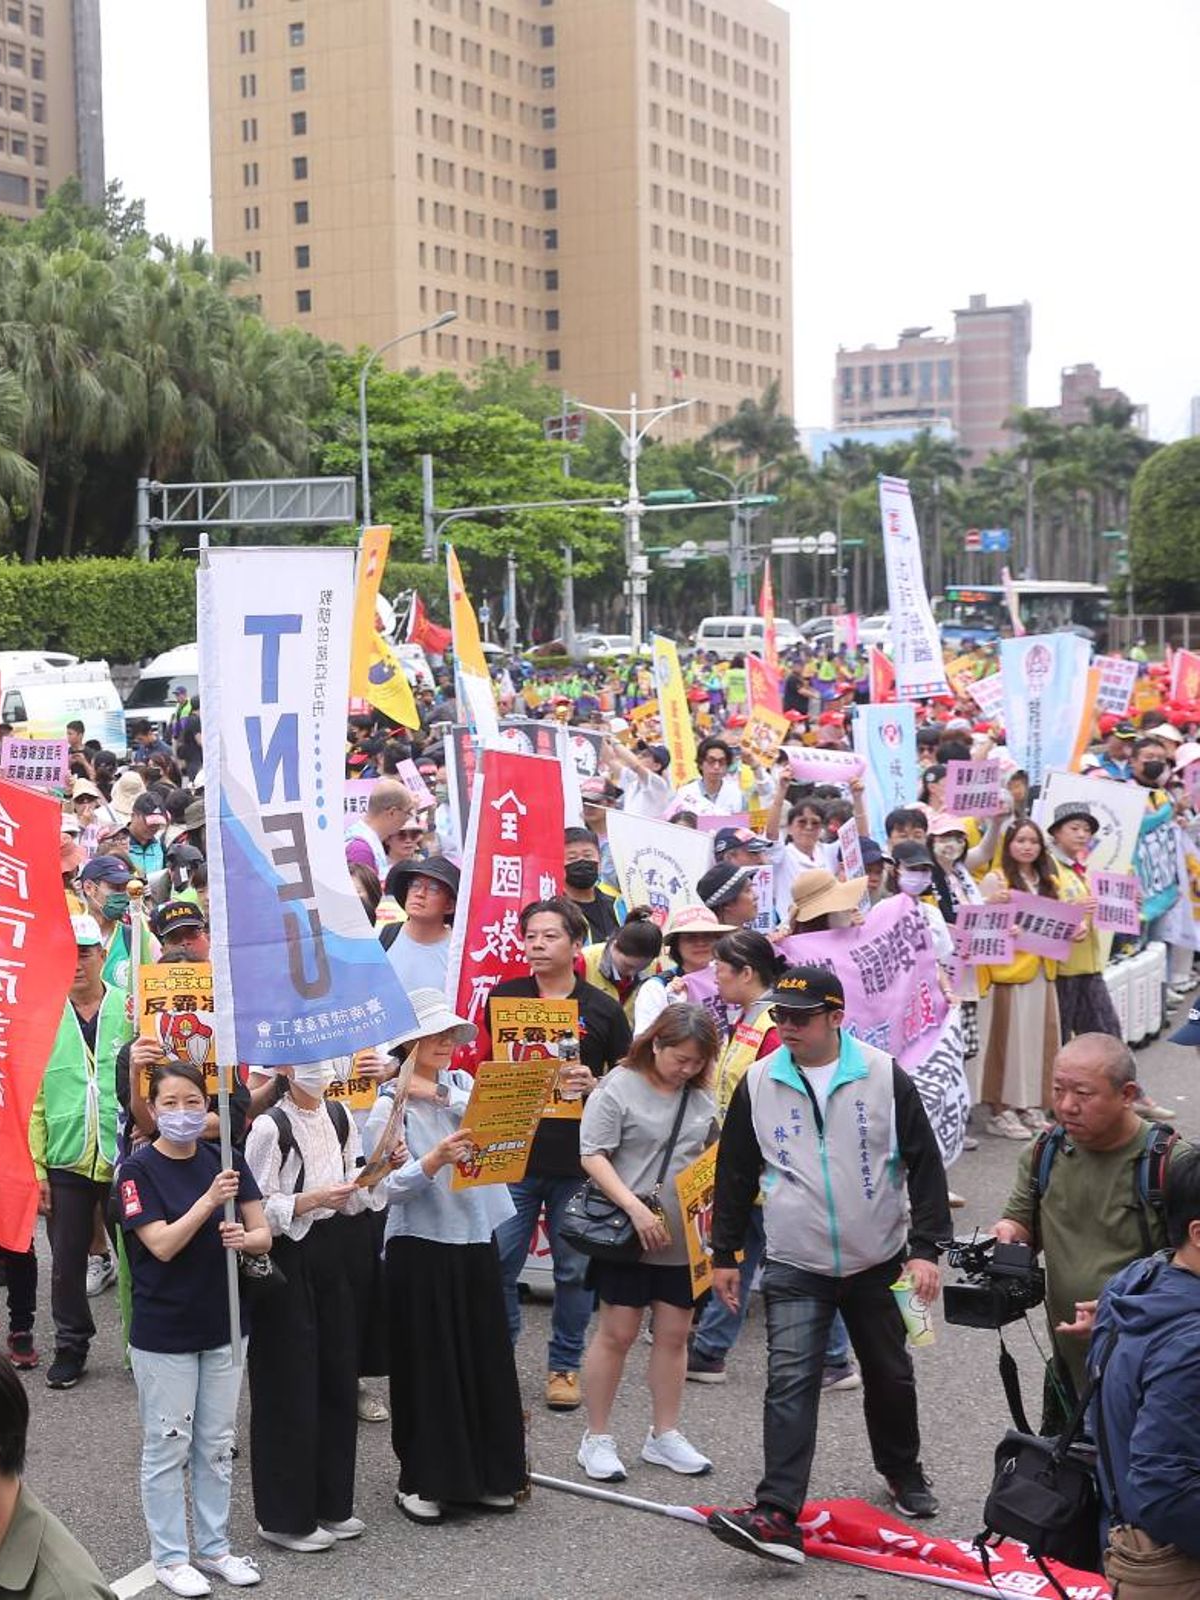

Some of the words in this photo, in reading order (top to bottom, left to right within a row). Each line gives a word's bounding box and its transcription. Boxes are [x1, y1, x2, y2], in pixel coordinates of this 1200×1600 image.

[496, 1010, 573, 1023] 五一勞工大遊行
